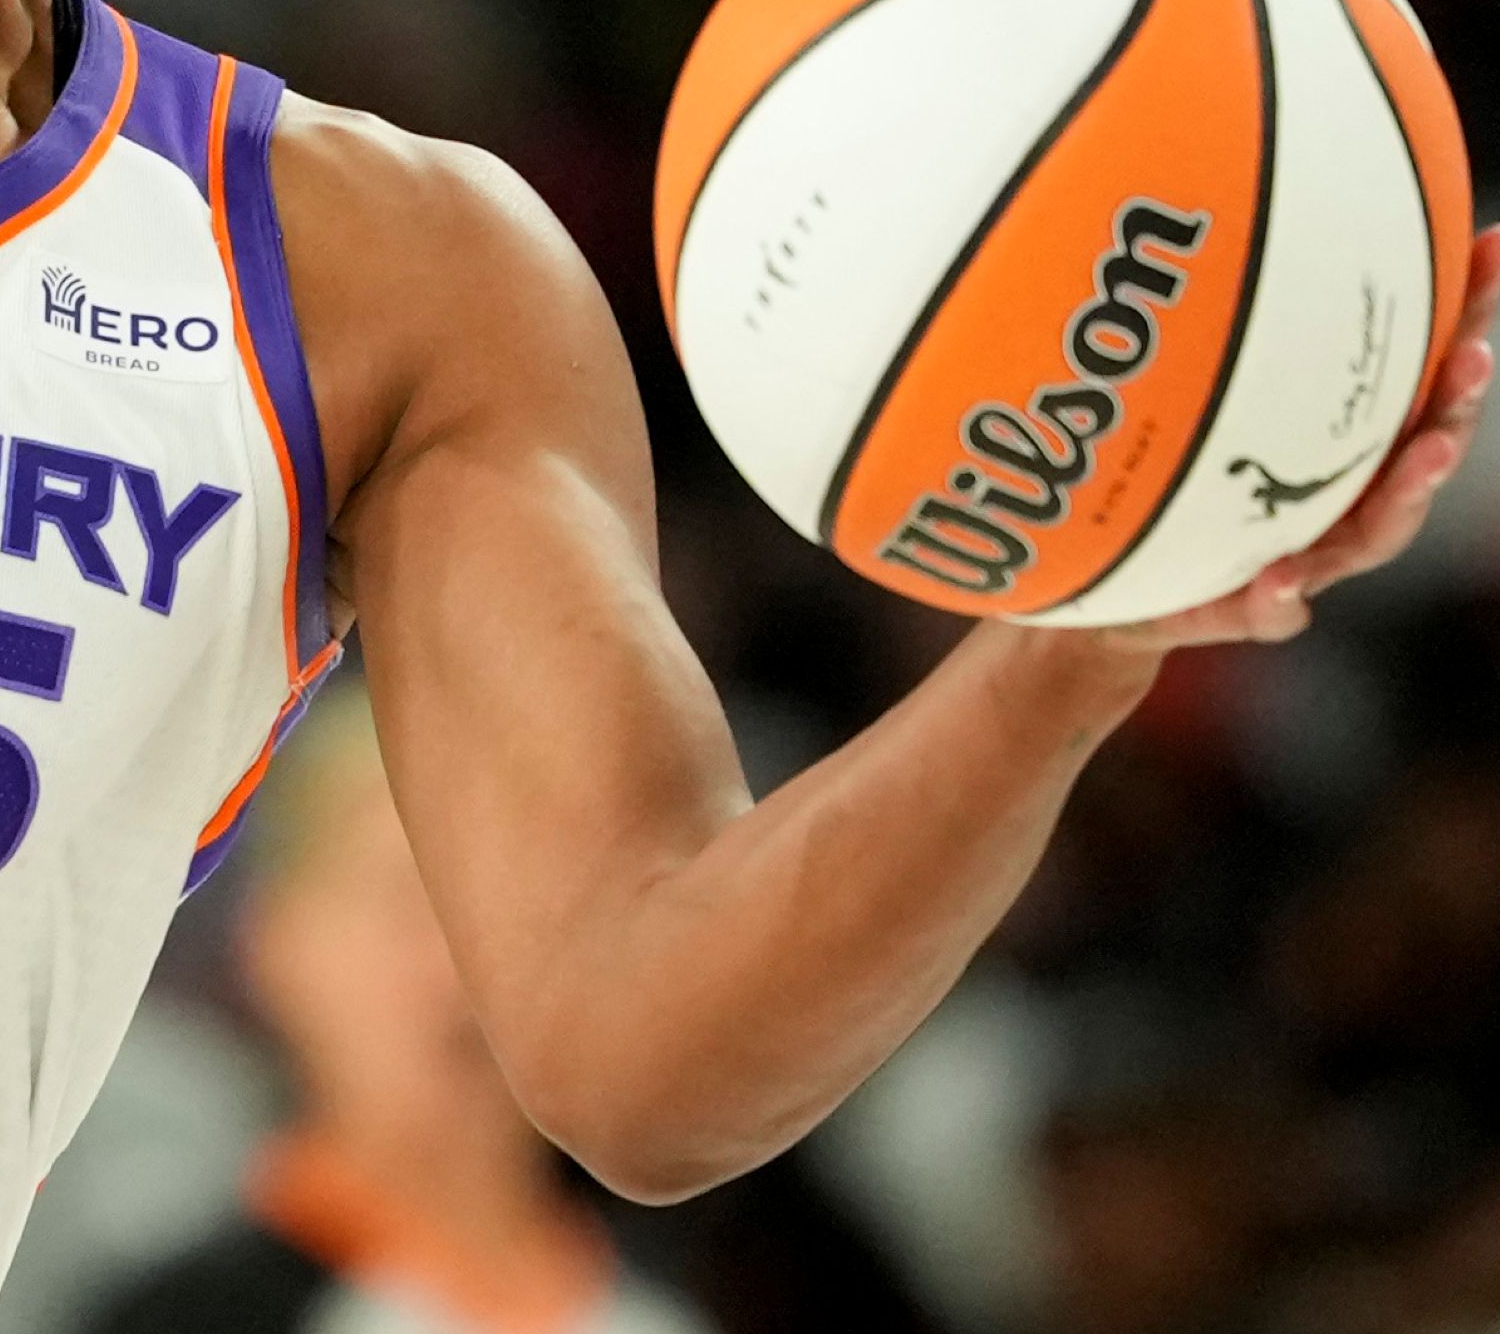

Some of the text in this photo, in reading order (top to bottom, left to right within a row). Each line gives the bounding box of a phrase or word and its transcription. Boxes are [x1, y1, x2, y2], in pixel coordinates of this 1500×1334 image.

[42, 271, 219, 352] HERO
[85, 350, 161, 372] BREAD
[876, 195, 1212, 595] Wilson
